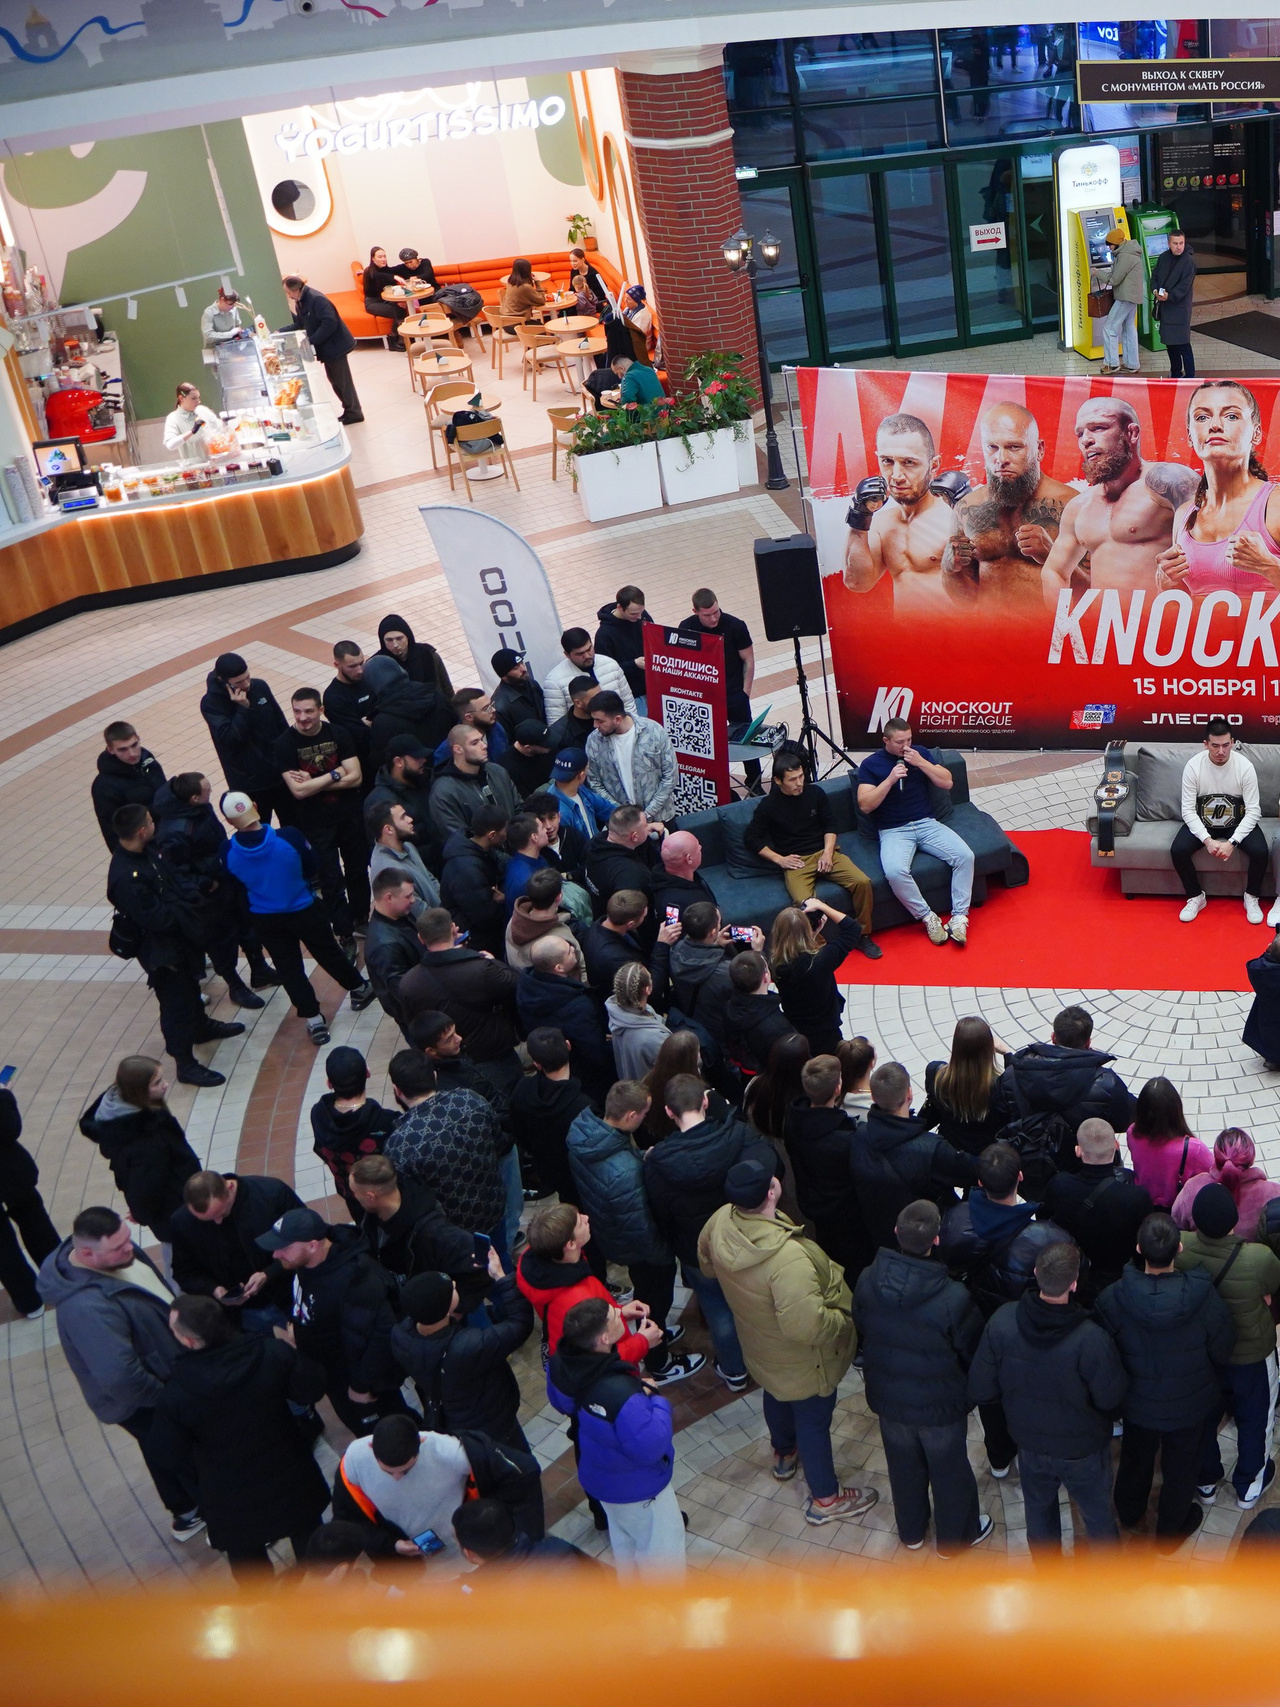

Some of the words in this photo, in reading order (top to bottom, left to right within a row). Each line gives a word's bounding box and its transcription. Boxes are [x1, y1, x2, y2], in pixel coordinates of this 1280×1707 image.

[1142, 71, 1178, 80] ВЫХОД
[1180, 71, 1187, 79] К
[1189, 70, 1225, 79] СКВЕРУ
[1102, 83, 1109, 92] С
[1110, 82, 1186, 92] МОНУМЕНТОМ
[1188, 81, 1219, 91] «МАТЬ
[1221, 81, 1266, 90] РОССИЯ»
[274, 95, 566, 163] YOGURTISSIMO
[1072, 178, 1109, 188] Тинькофф
[975, 227, 1001, 236] ВЫХОД
[1074, 268, 1084, 329] Тинькофф
[652, 654, 719, 676] ПОДПИШИСЬ
[662, 667, 683, 677] НАШИ
[683, 670, 719, 684] АККАУНТЫ
[670, 686, 703, 698] ВКОНТАКТЕ
[1133, 678, 1156, 695] 15
[1163, 679, 1256, 696] НОЯБРЯ
[921, 701, 1013, 714] KNOCKOUT
[919, 715, 957, 726] FIGHT
[961, 715, 1012, 726] LEAGUE
[677, 763, 706, 774] TELEGRAM
